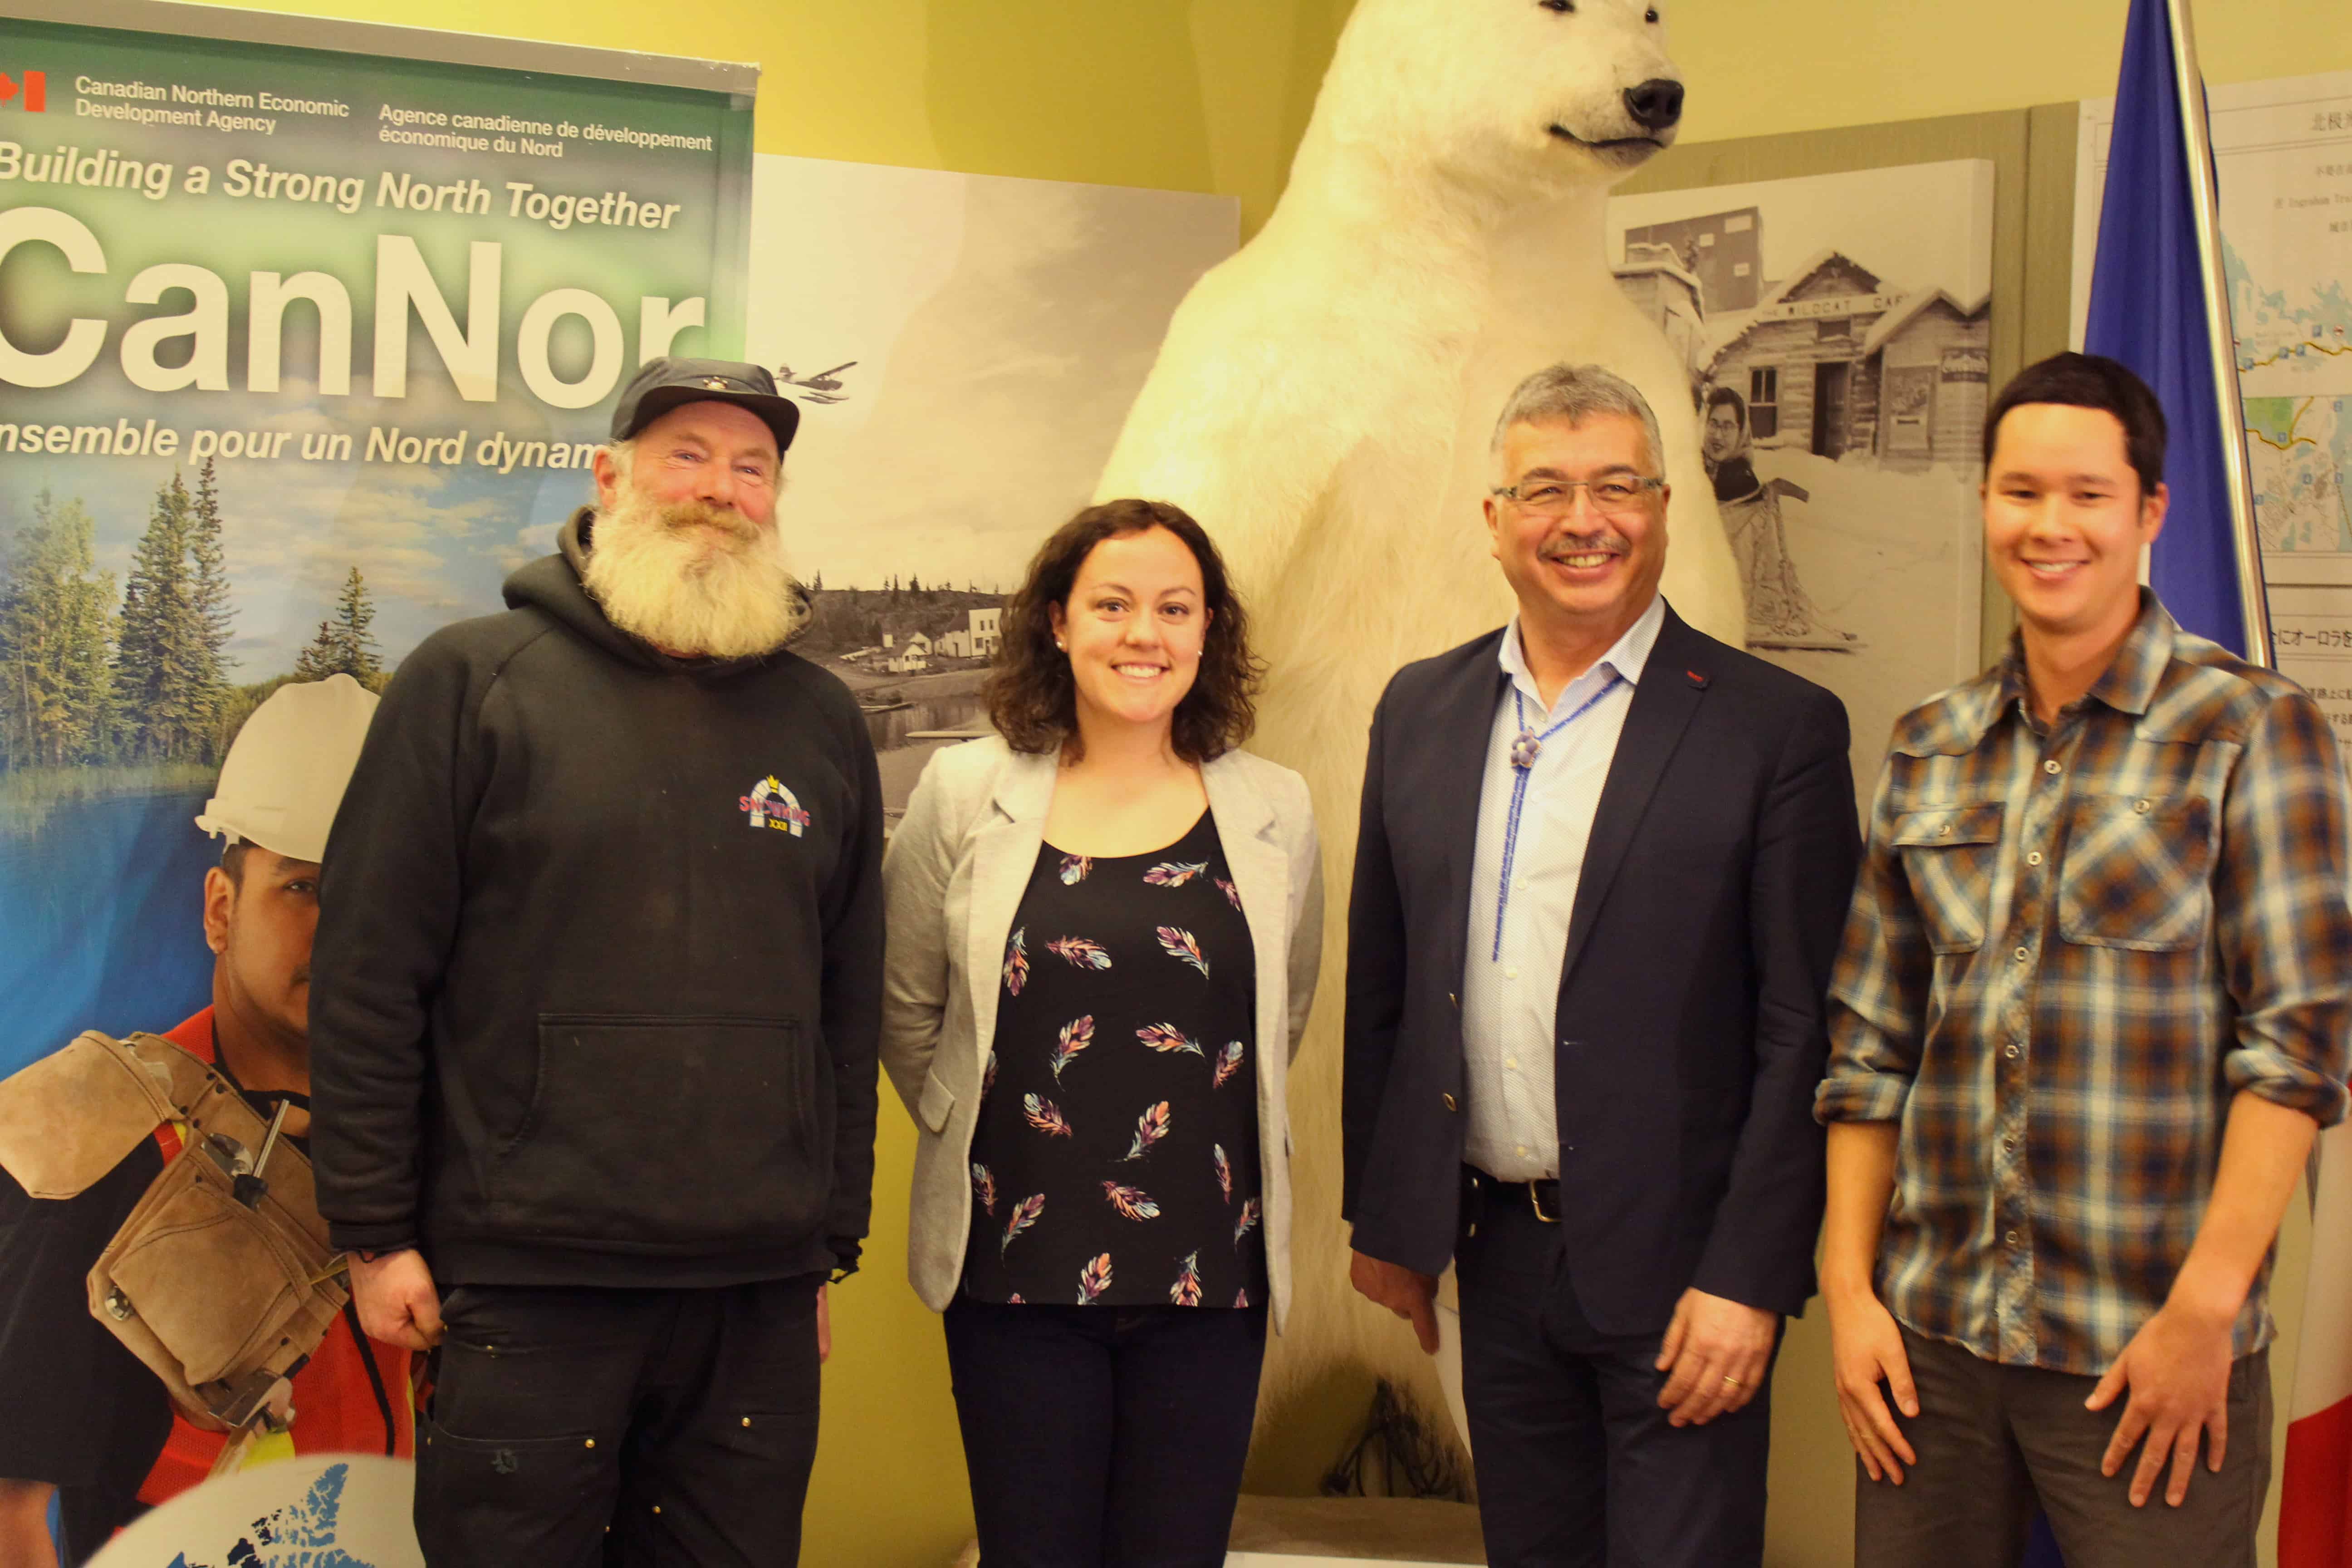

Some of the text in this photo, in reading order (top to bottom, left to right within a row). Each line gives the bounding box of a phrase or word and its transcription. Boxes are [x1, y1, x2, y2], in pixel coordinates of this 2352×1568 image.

[76, 76, 350, 117] Canadian Northern Economic
[76, 98, 276, 135] Development Agency
[379, 104, 713, 151] Agence canadienne de développement
[379, 127, 563, 157] économique du Nord
[0, 142, 680, 230] Building a Strong North Together
[0, 206, 706, 409] CanNor
[1873, 293, 1910, 309] CAF
[189, 430, 292, 465] pour
[302, 434, 352, 461] un
[365, 427, 468, 465] Nord
